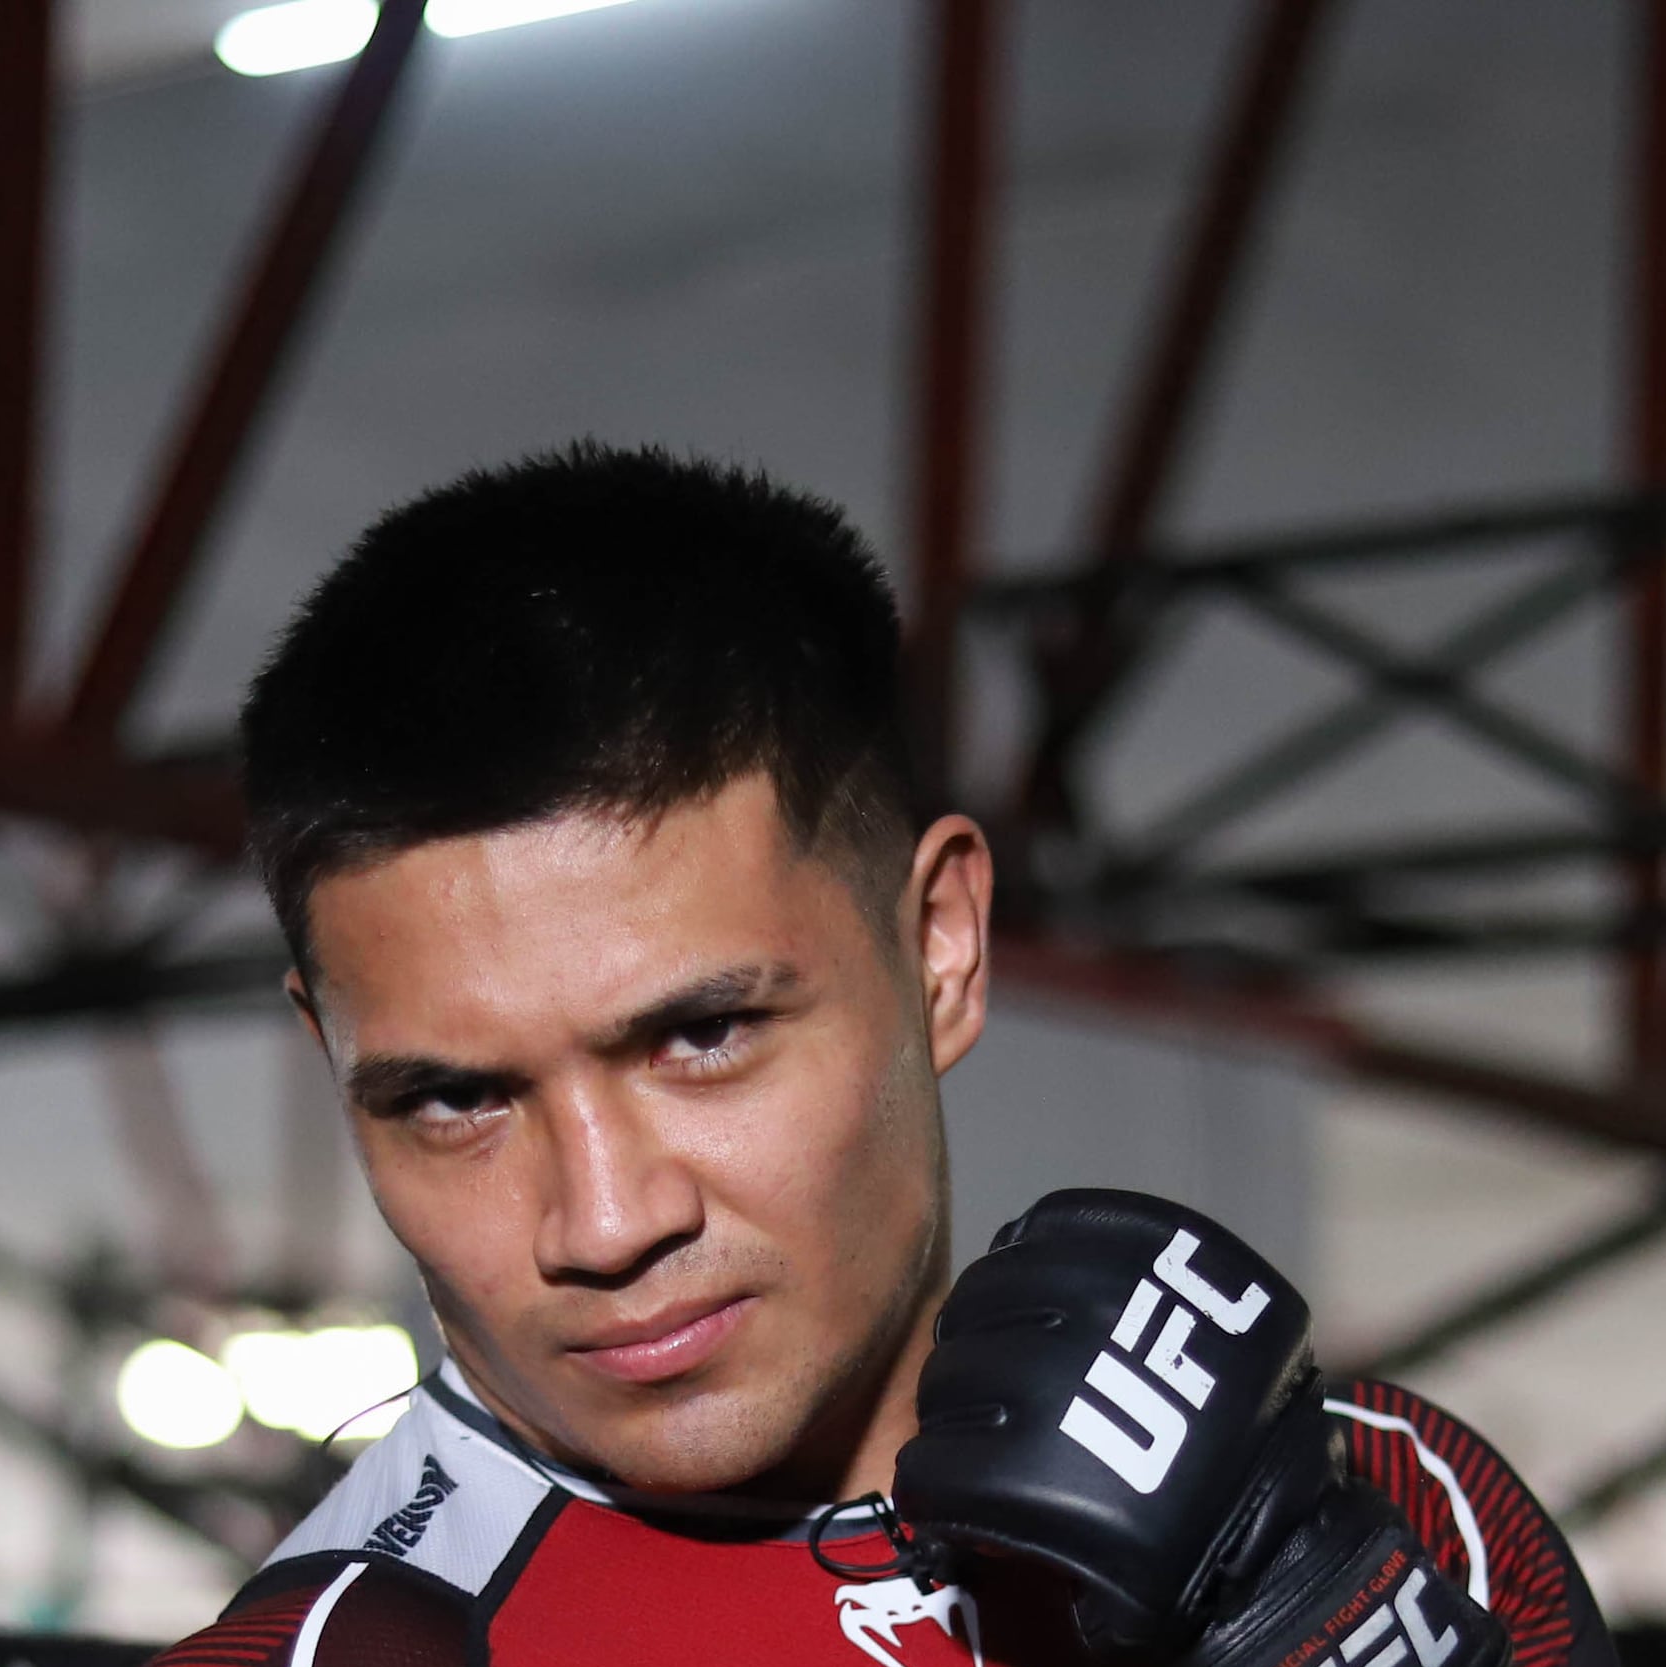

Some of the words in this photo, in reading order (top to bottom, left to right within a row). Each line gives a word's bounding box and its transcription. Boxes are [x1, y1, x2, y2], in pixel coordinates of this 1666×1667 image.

[1057, 1226, 1272, 1496] UFC
[1323, 1589, 1372, 1636] FIGHT
[1367, 1549, 1409, 1593] GLOVE
